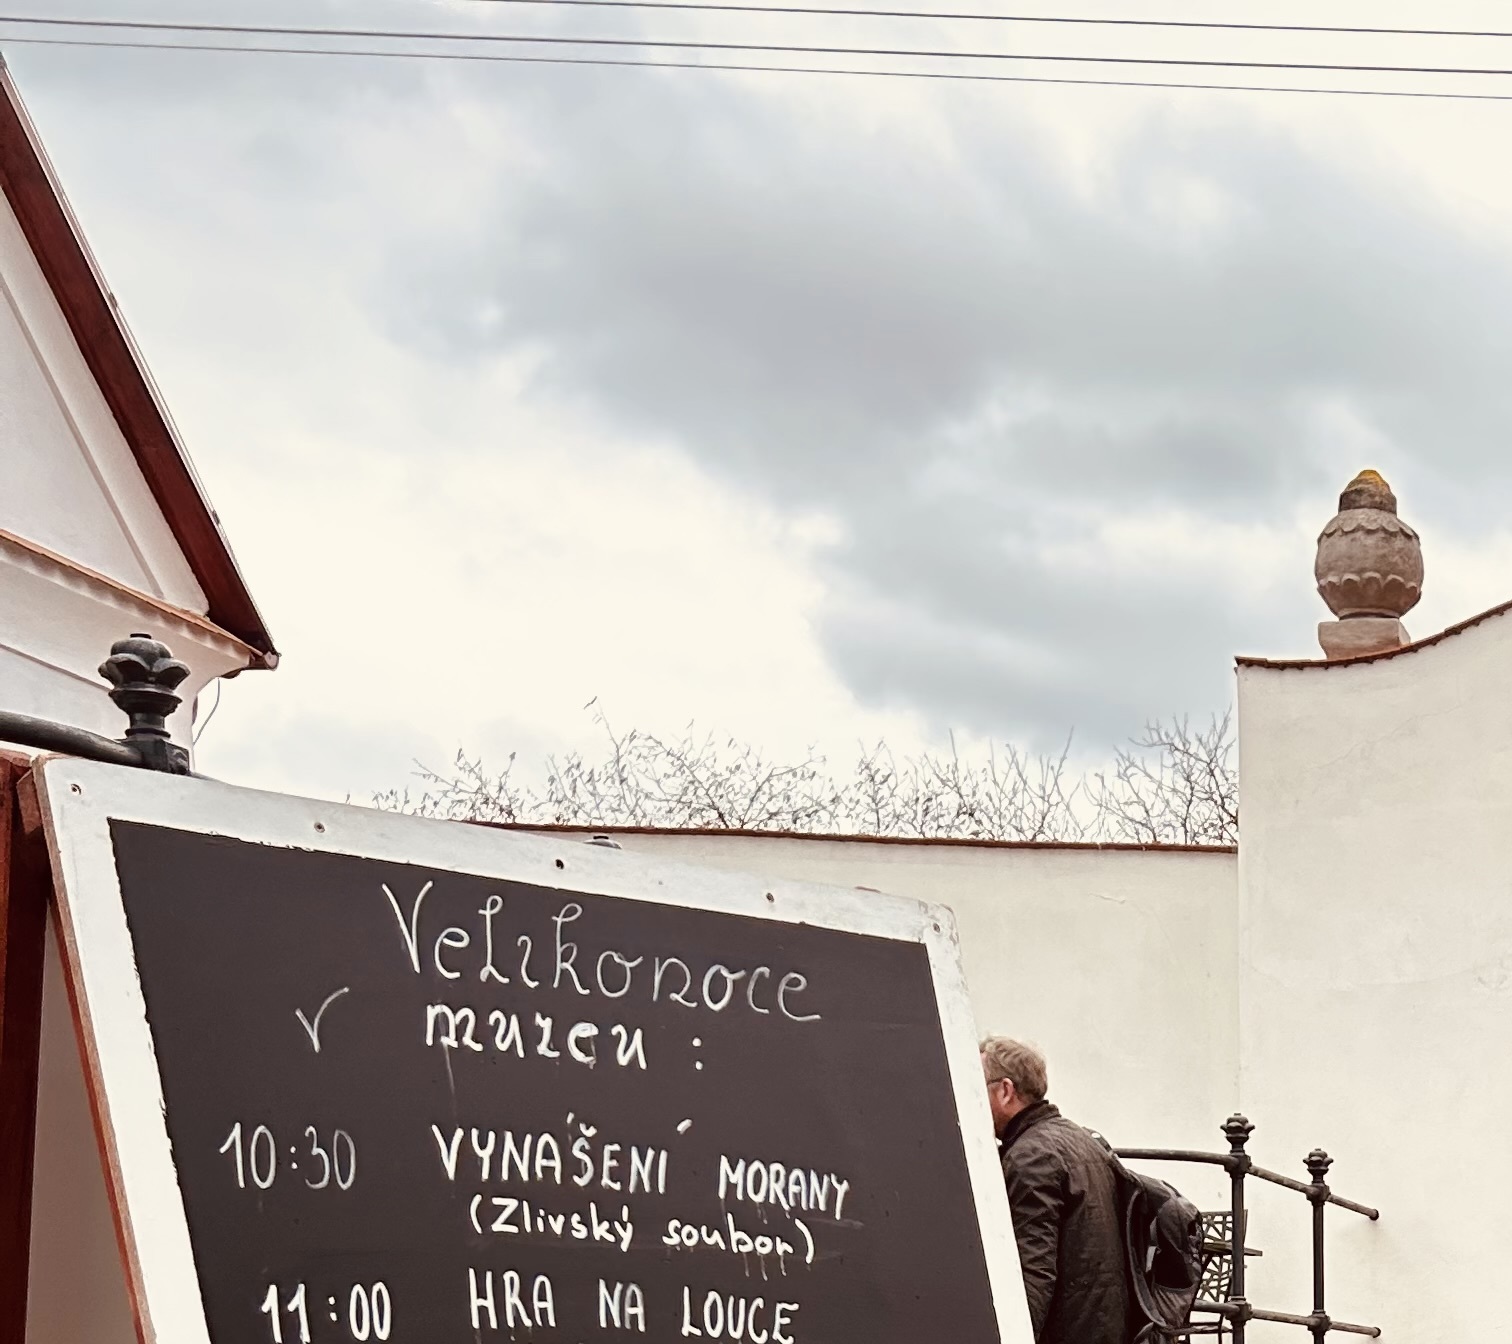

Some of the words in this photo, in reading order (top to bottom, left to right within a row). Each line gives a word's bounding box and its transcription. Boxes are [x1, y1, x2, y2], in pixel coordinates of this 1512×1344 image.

[219, 1122, 357, 1191] 10:30
[431, 1112, 692, 1194] VYNÁŠENÍ
[718, 1154, 850, 1220] MORANY
[469, 1194, 634, 1252] (Zlivský
[662, 1212, 816, 1265] soubor)
[260, 1281, 392, 1344] 11:00
[468, 1268, 556, 1331] HRA
[599, 1278, 646, 1332] NA
